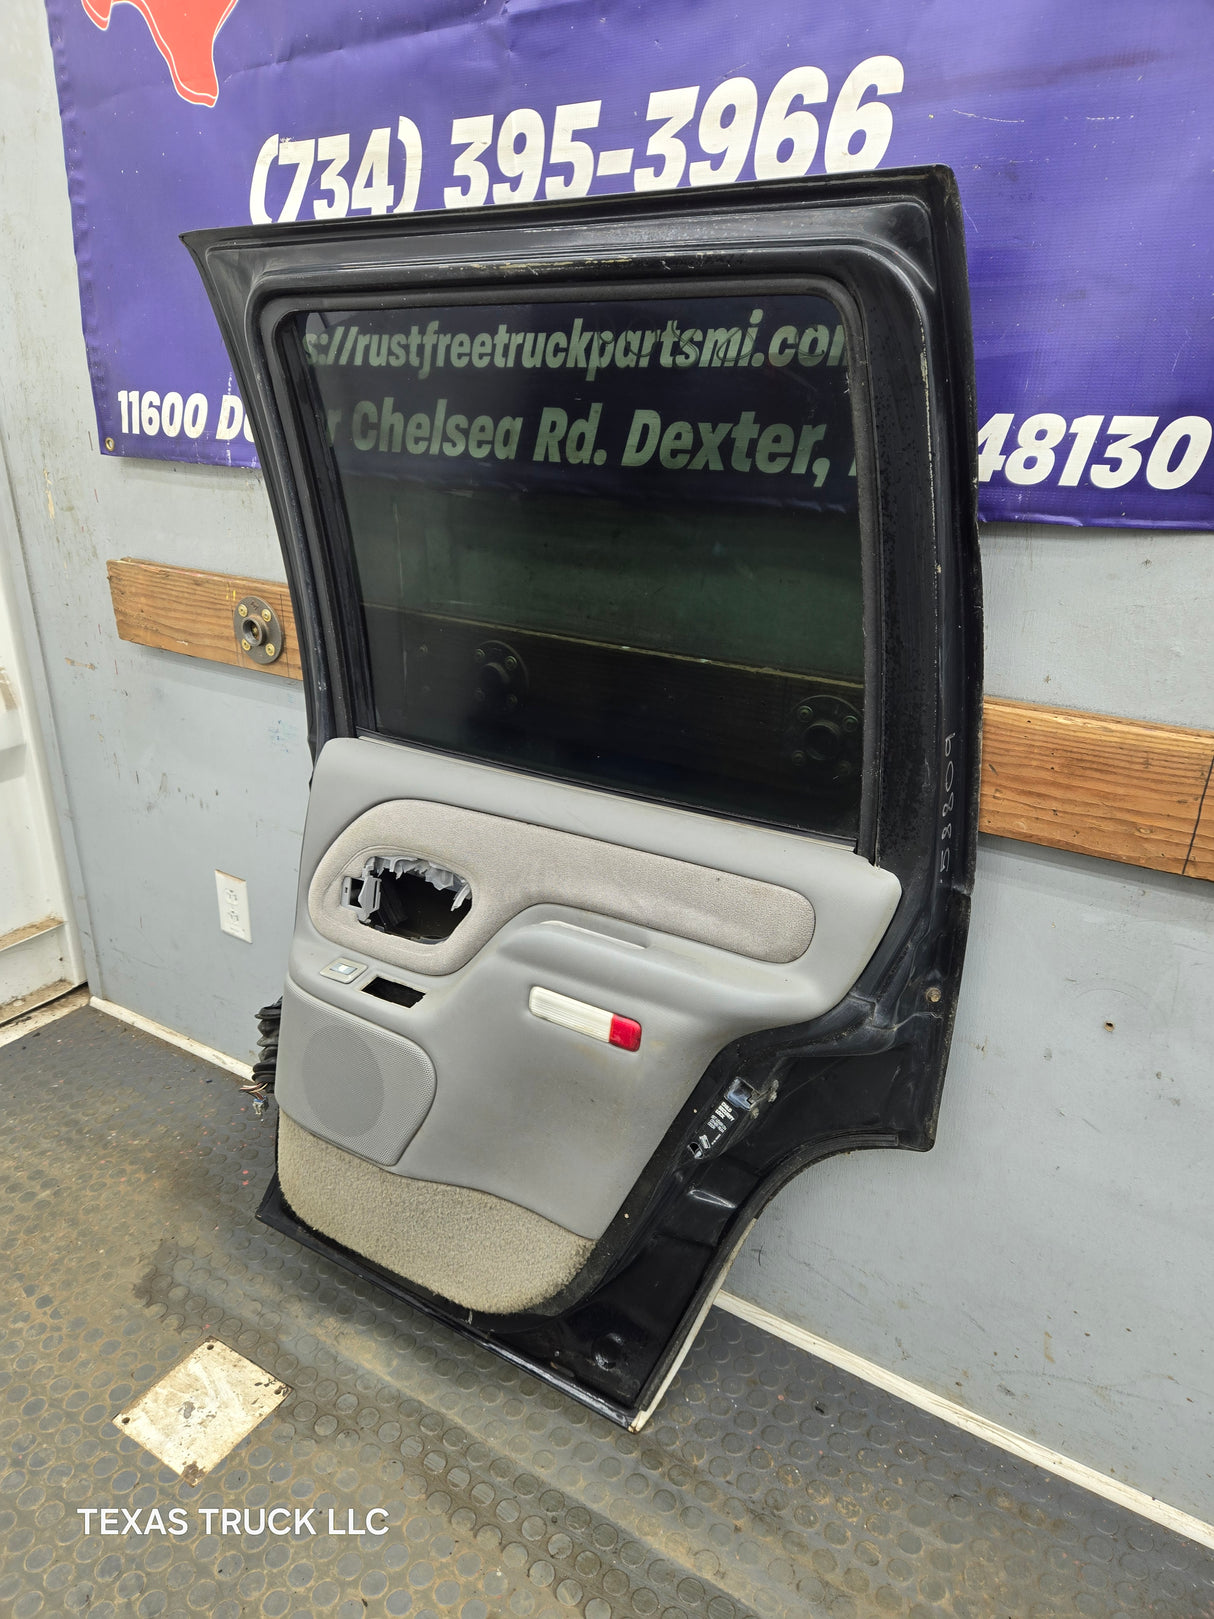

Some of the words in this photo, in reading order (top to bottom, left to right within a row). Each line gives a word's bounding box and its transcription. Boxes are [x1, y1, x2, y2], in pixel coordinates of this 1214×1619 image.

[250, 116, 423, 225] (734)
[444, 55, 904, 209] 395-3966
[118, 390, 208, 439] 11600
[216, 394, 255, 443] D
[352, 397, 523, 459] Chelsea
[532, 402, 607, 465] Rd.
[621, 409, 830, 487] Dexter,
[978, 413, 1212, 490] 48130
[940, 732, 956, 872] 58809
